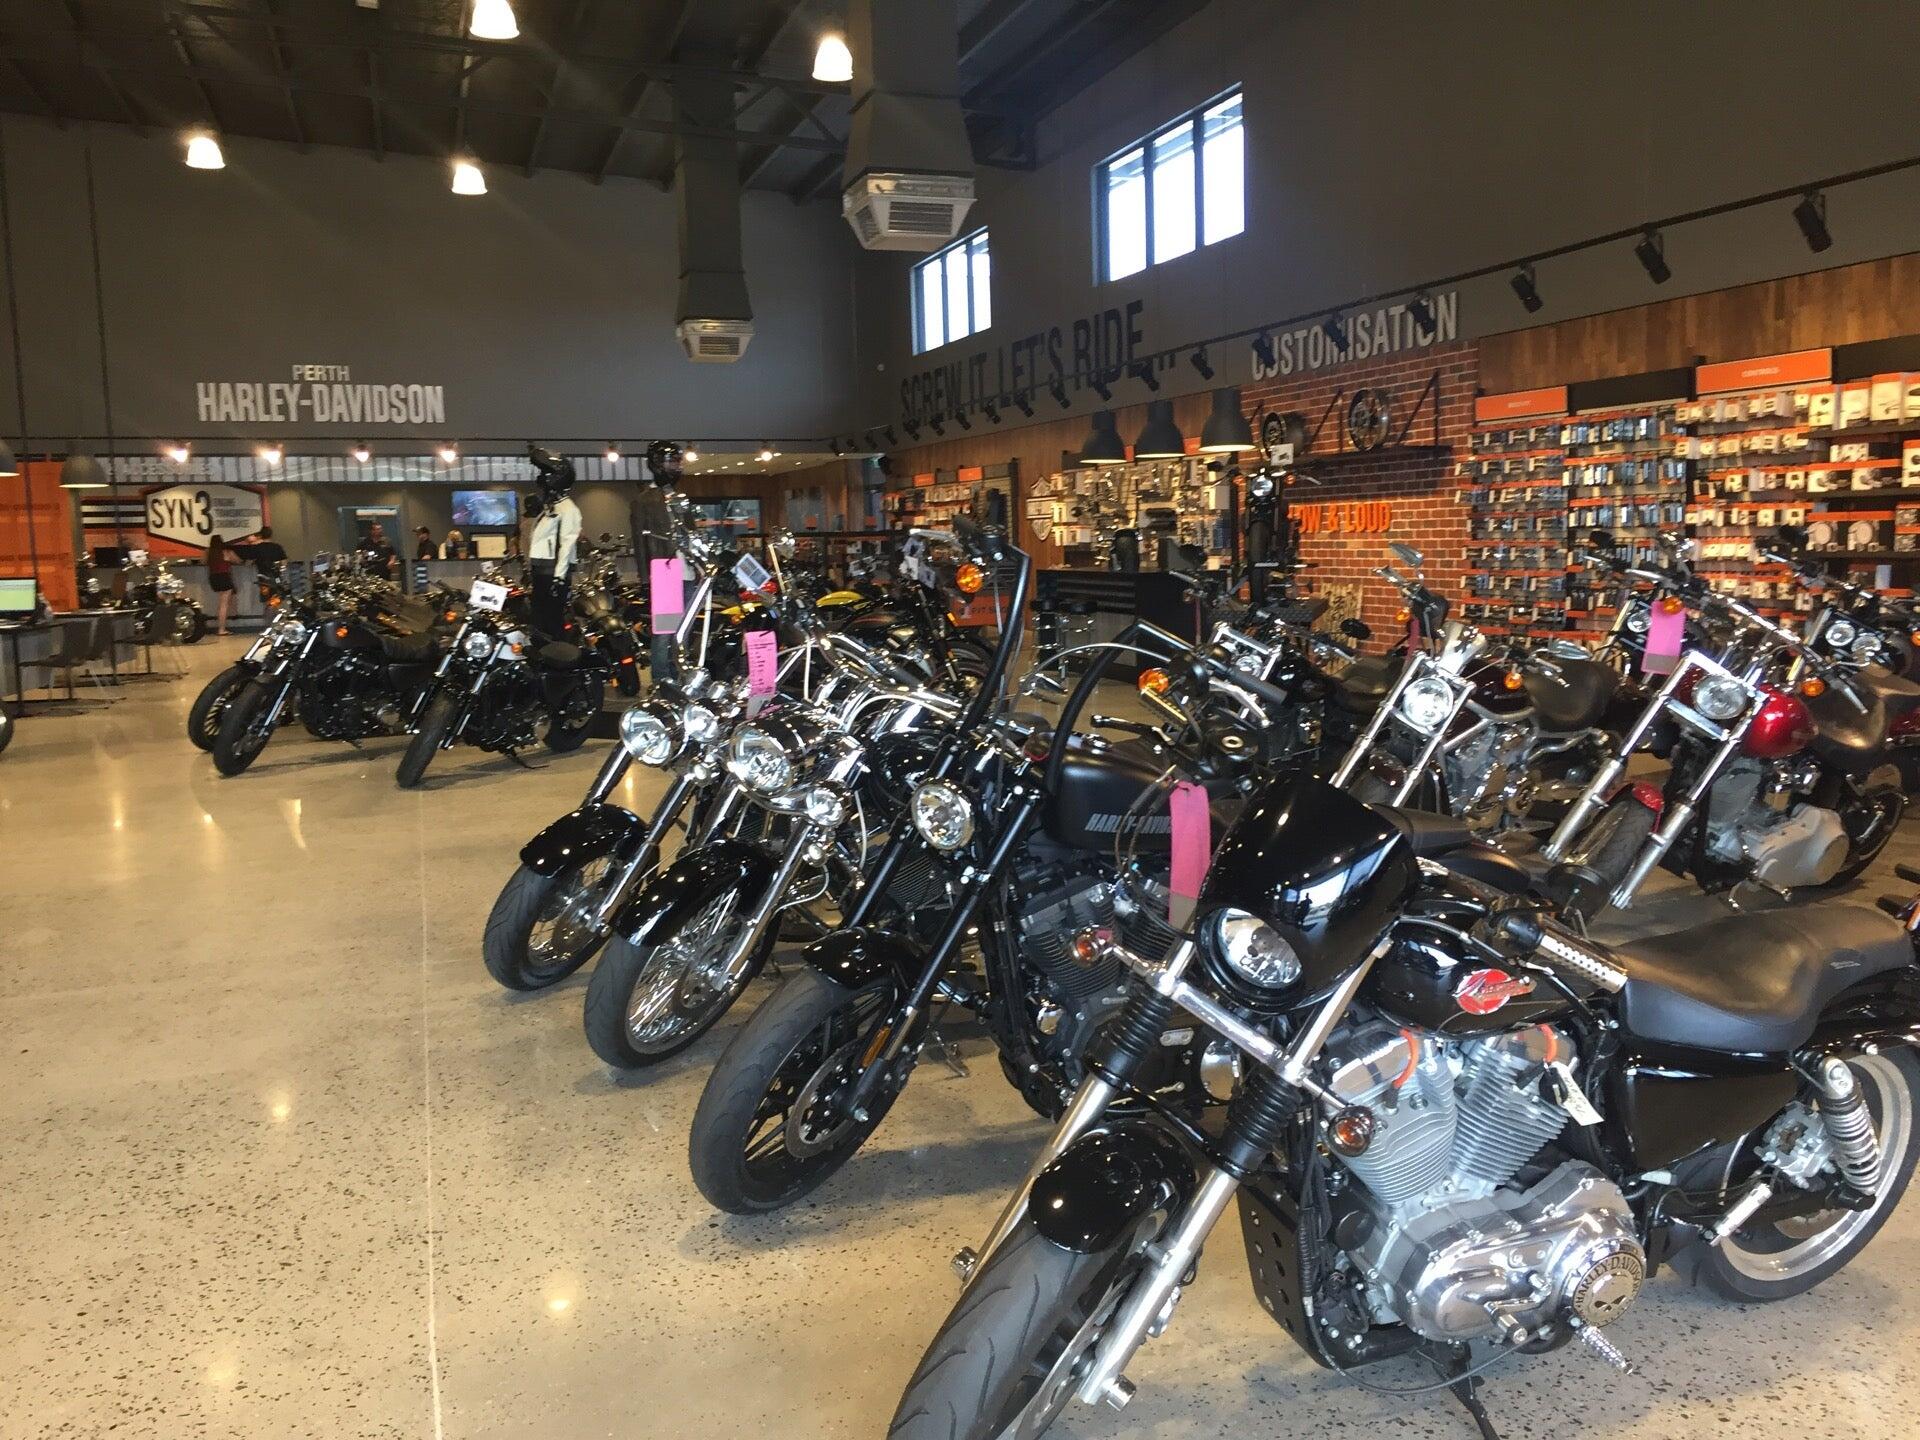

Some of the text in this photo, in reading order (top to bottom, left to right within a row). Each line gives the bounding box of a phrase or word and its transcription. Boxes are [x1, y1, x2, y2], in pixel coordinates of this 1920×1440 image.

[292, 364, 350, 381] PERTH
[901, 360, 962, 424] SCREW
[999, 326, 1063, 408] LET'S
[196, 382, 446, 424] HARLEY-DAVIDSON
[1327, 504, 1339, 532] &
[1343, 502, 1393, 533] LOUD
